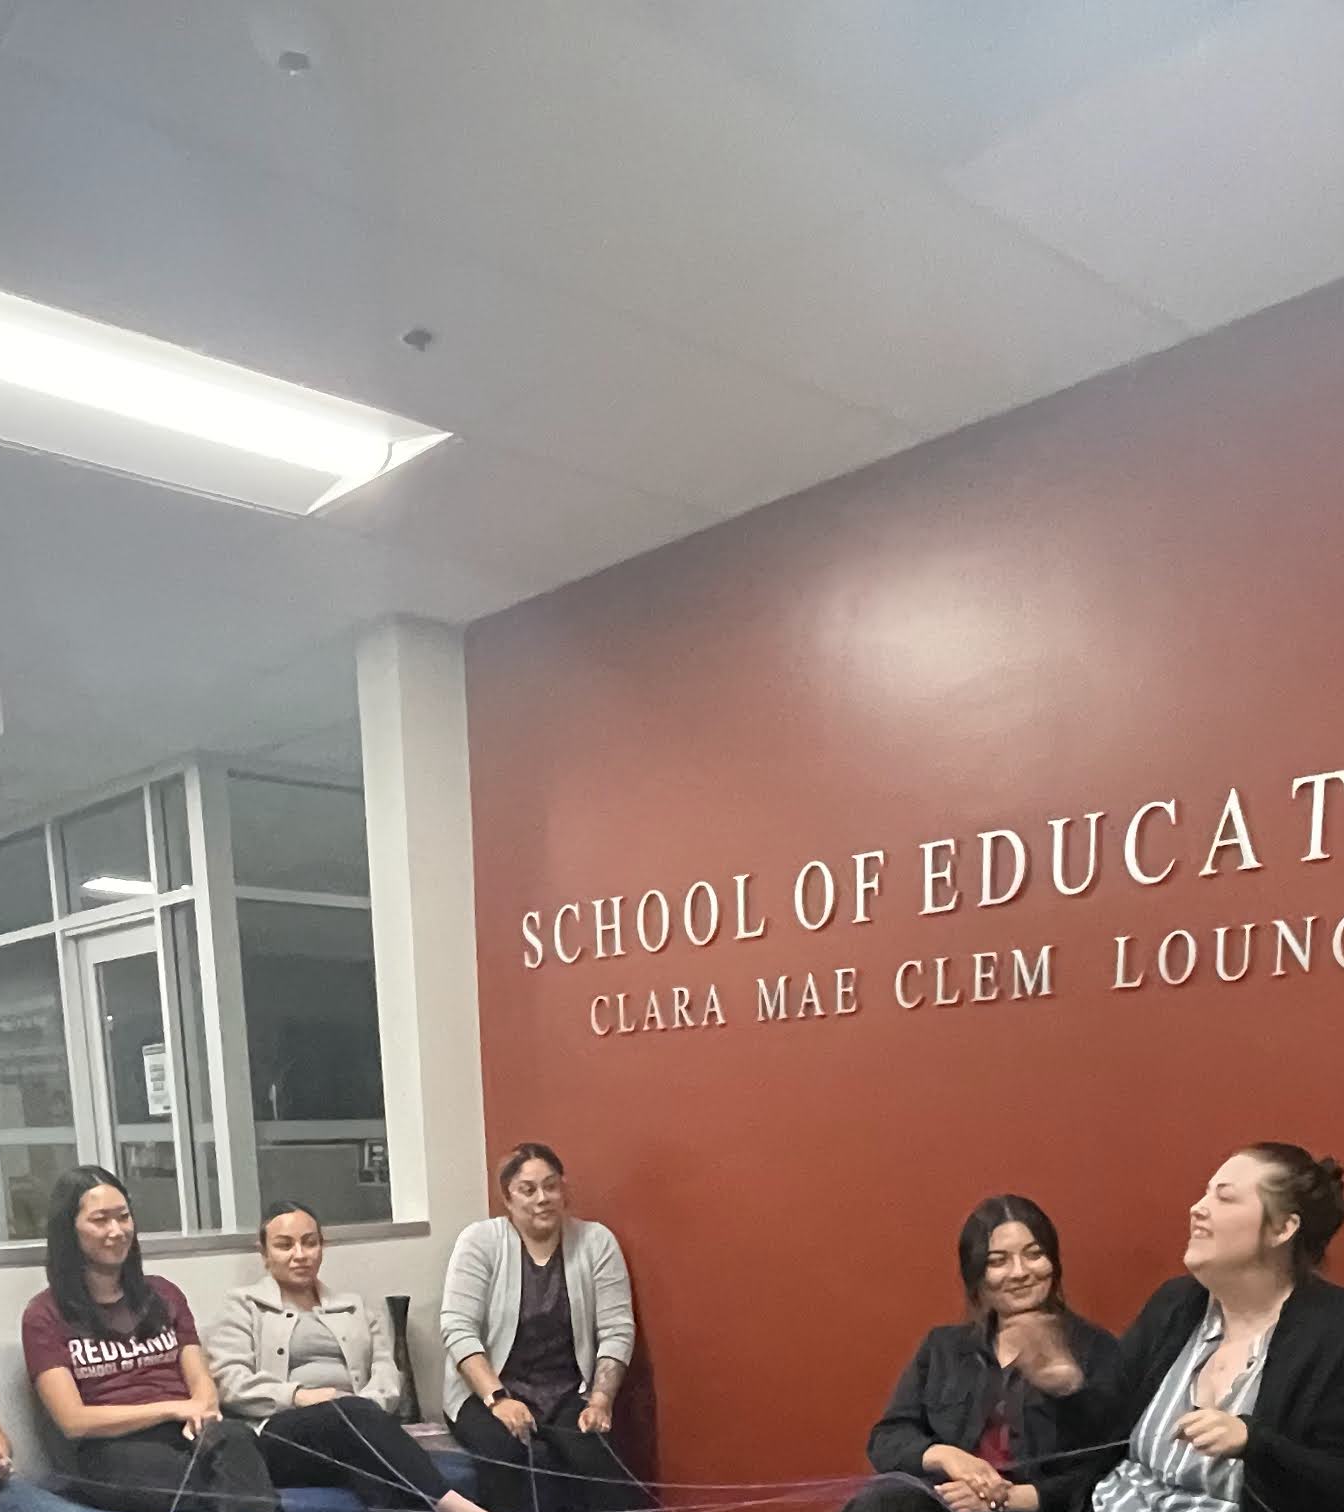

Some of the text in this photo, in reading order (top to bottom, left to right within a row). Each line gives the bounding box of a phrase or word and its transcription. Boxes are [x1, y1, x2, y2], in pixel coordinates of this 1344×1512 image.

[522, 873, 766, 970] SCHOOL
[794, 850, 885, 931] OF
[590, 983, 727, 1037] CLARA
[756, 967, 858, 1023] MAE
[894, 944, 1054, 1009] CLEM
